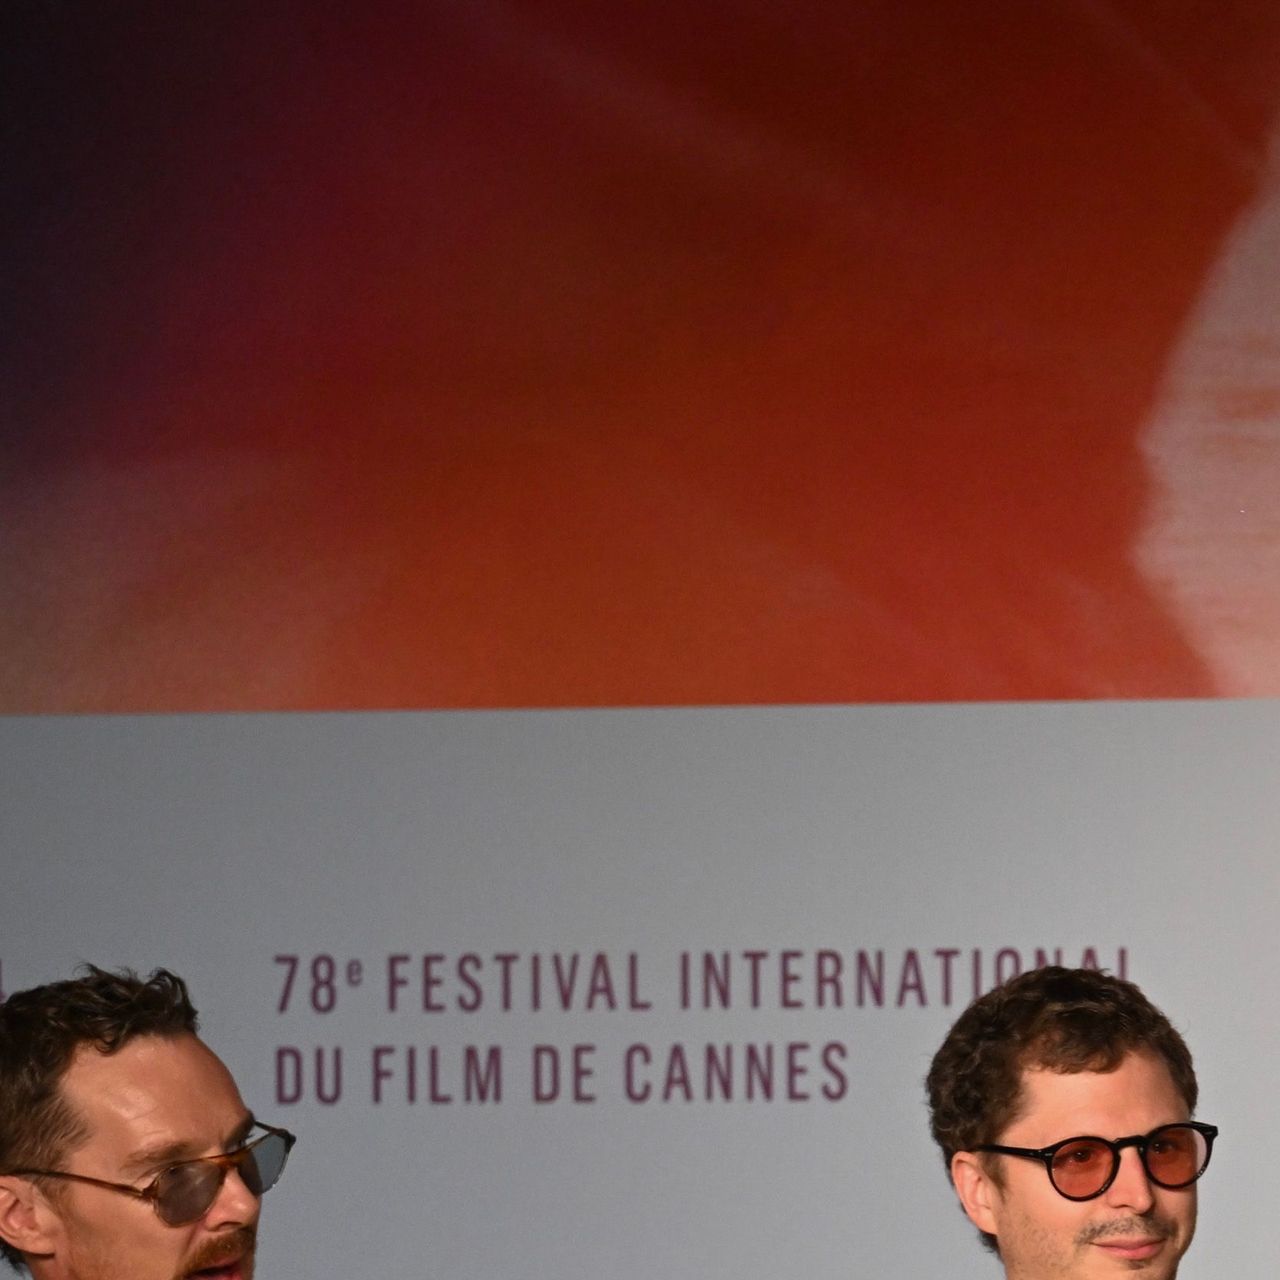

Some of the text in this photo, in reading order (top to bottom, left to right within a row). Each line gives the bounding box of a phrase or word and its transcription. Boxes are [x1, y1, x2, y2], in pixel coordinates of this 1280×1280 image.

[387, 951, 653, 1014] FESTIVAL
[274, 1042, 849, 1107] DU FILM DE CANNES
